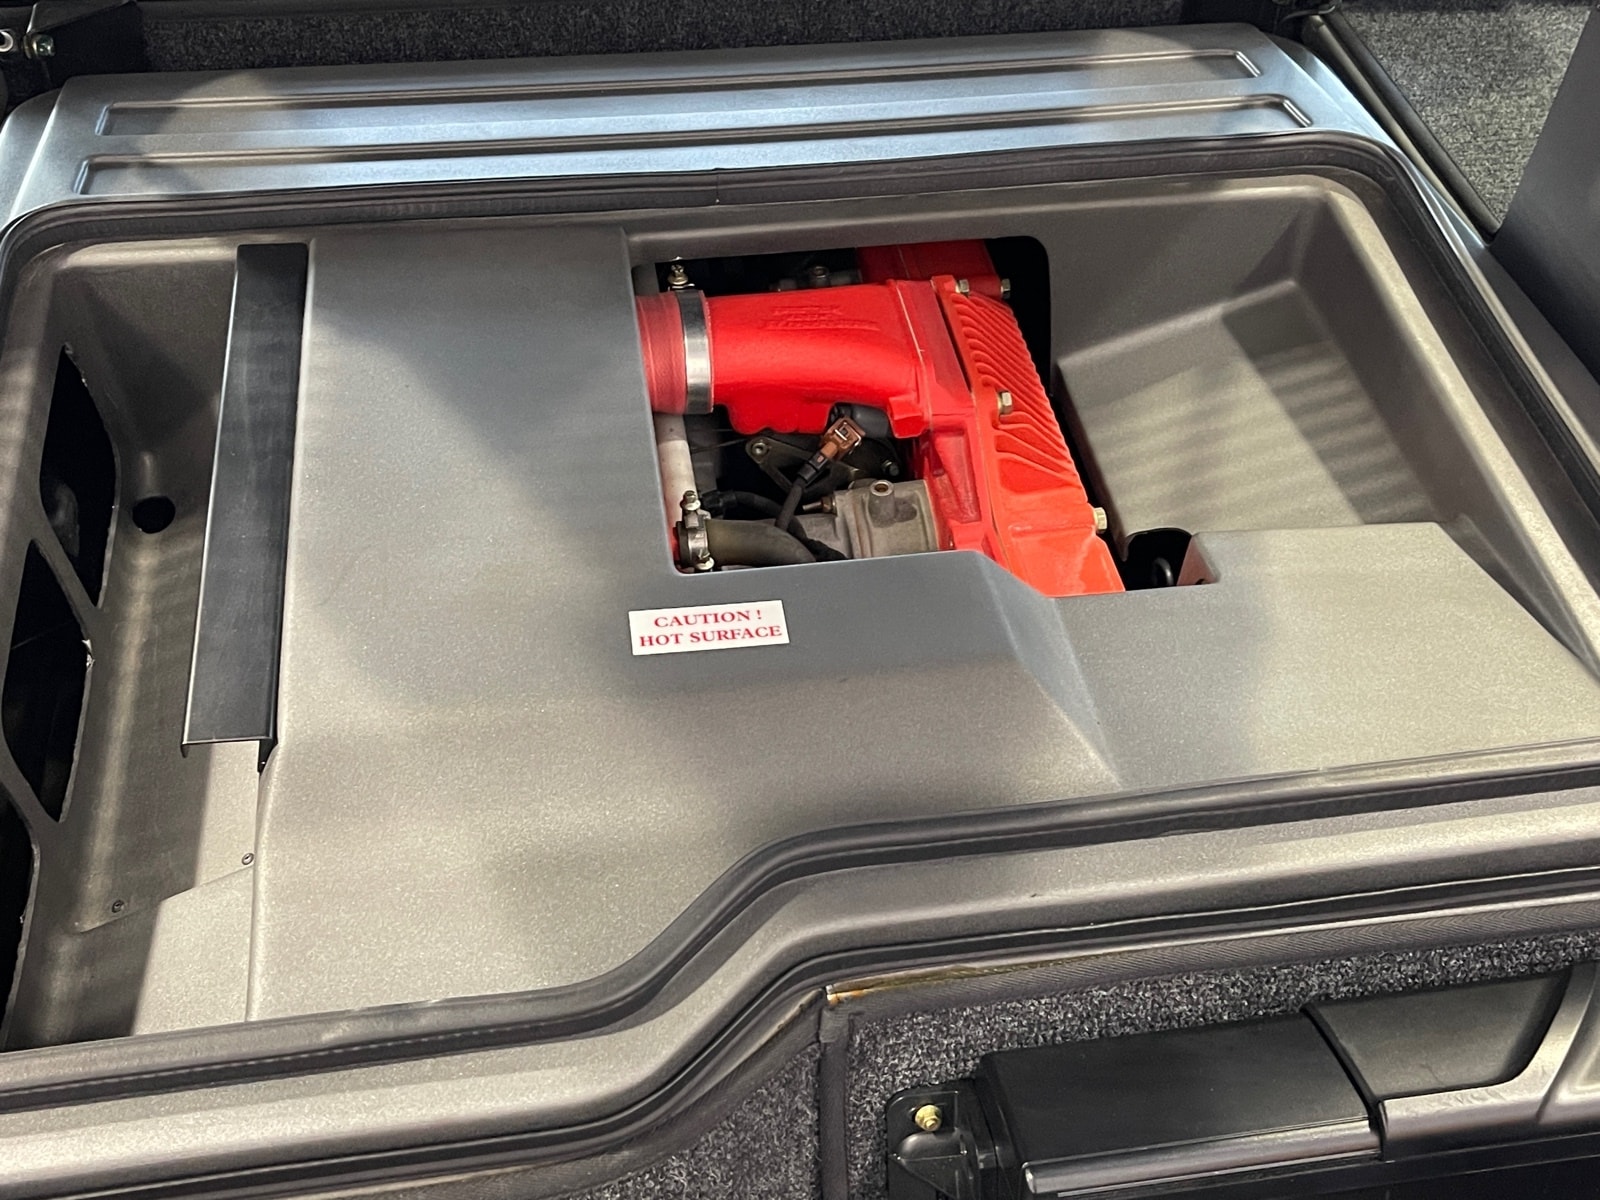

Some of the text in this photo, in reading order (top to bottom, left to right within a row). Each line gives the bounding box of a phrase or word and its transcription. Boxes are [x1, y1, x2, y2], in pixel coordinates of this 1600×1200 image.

[654, 610, 750, 627] CAUTION
[639, 625, 783, 647] HOT SURFACE
